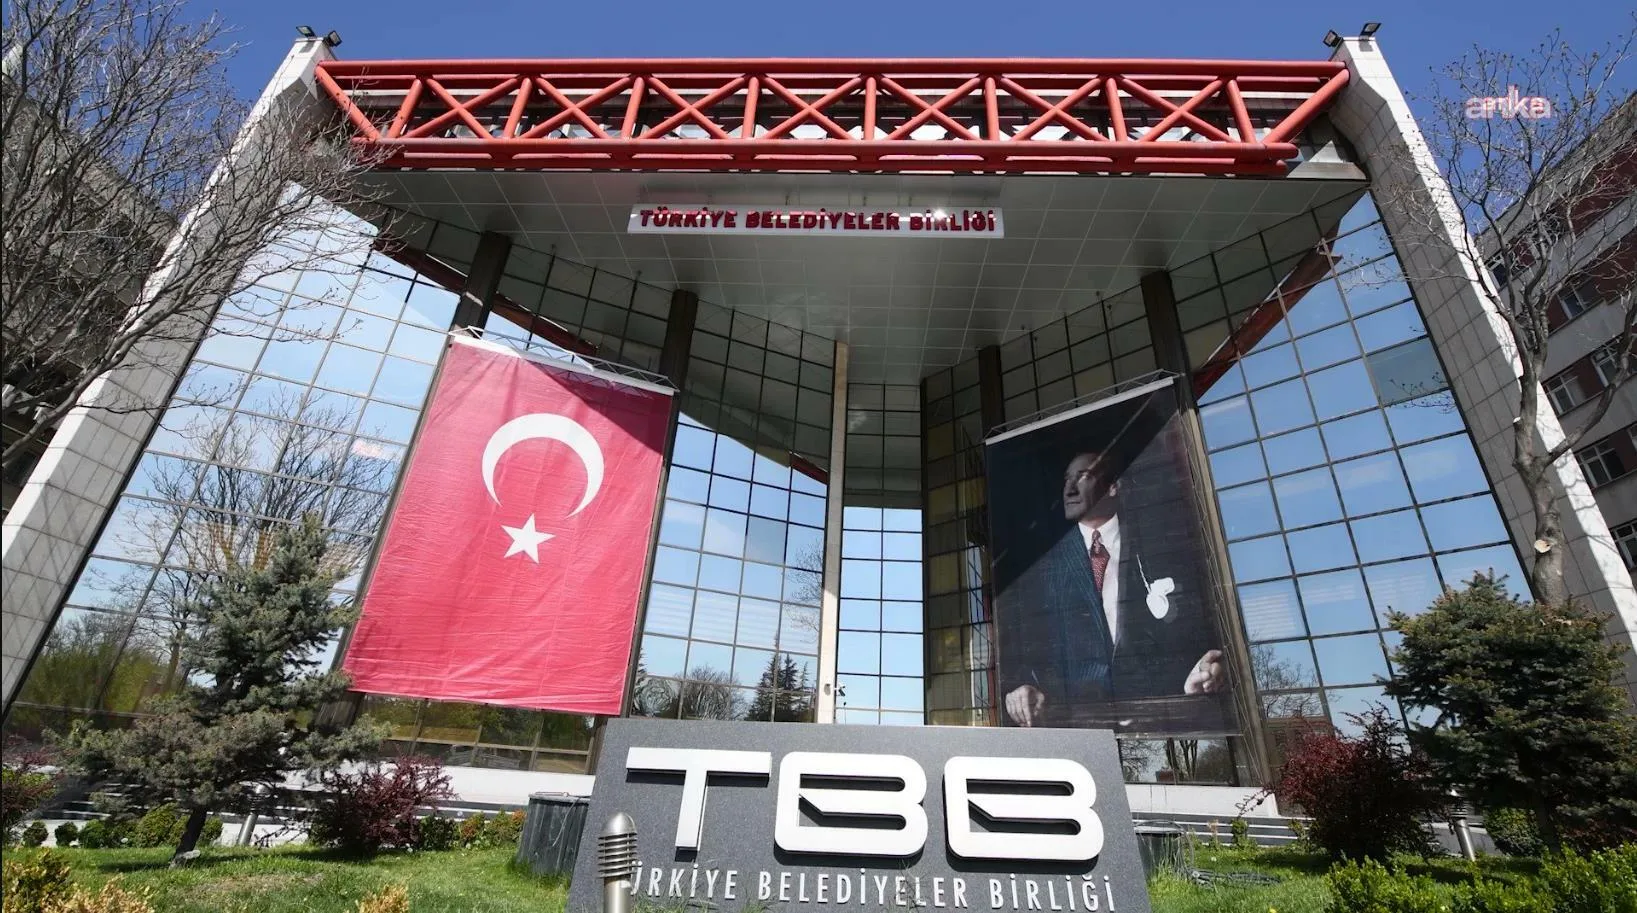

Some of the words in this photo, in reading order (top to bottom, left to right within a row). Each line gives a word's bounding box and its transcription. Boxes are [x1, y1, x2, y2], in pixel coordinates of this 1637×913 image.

[640, 206, 737, 229] TÜRKİYE
[745, 208, 900, 231] BELEDİYELER
[626, 747, 1104, 860] TBB
[758, 868, 968, 908] BELEDİYELER
[989, 873, 1115, 912] BİRLİĞİ
